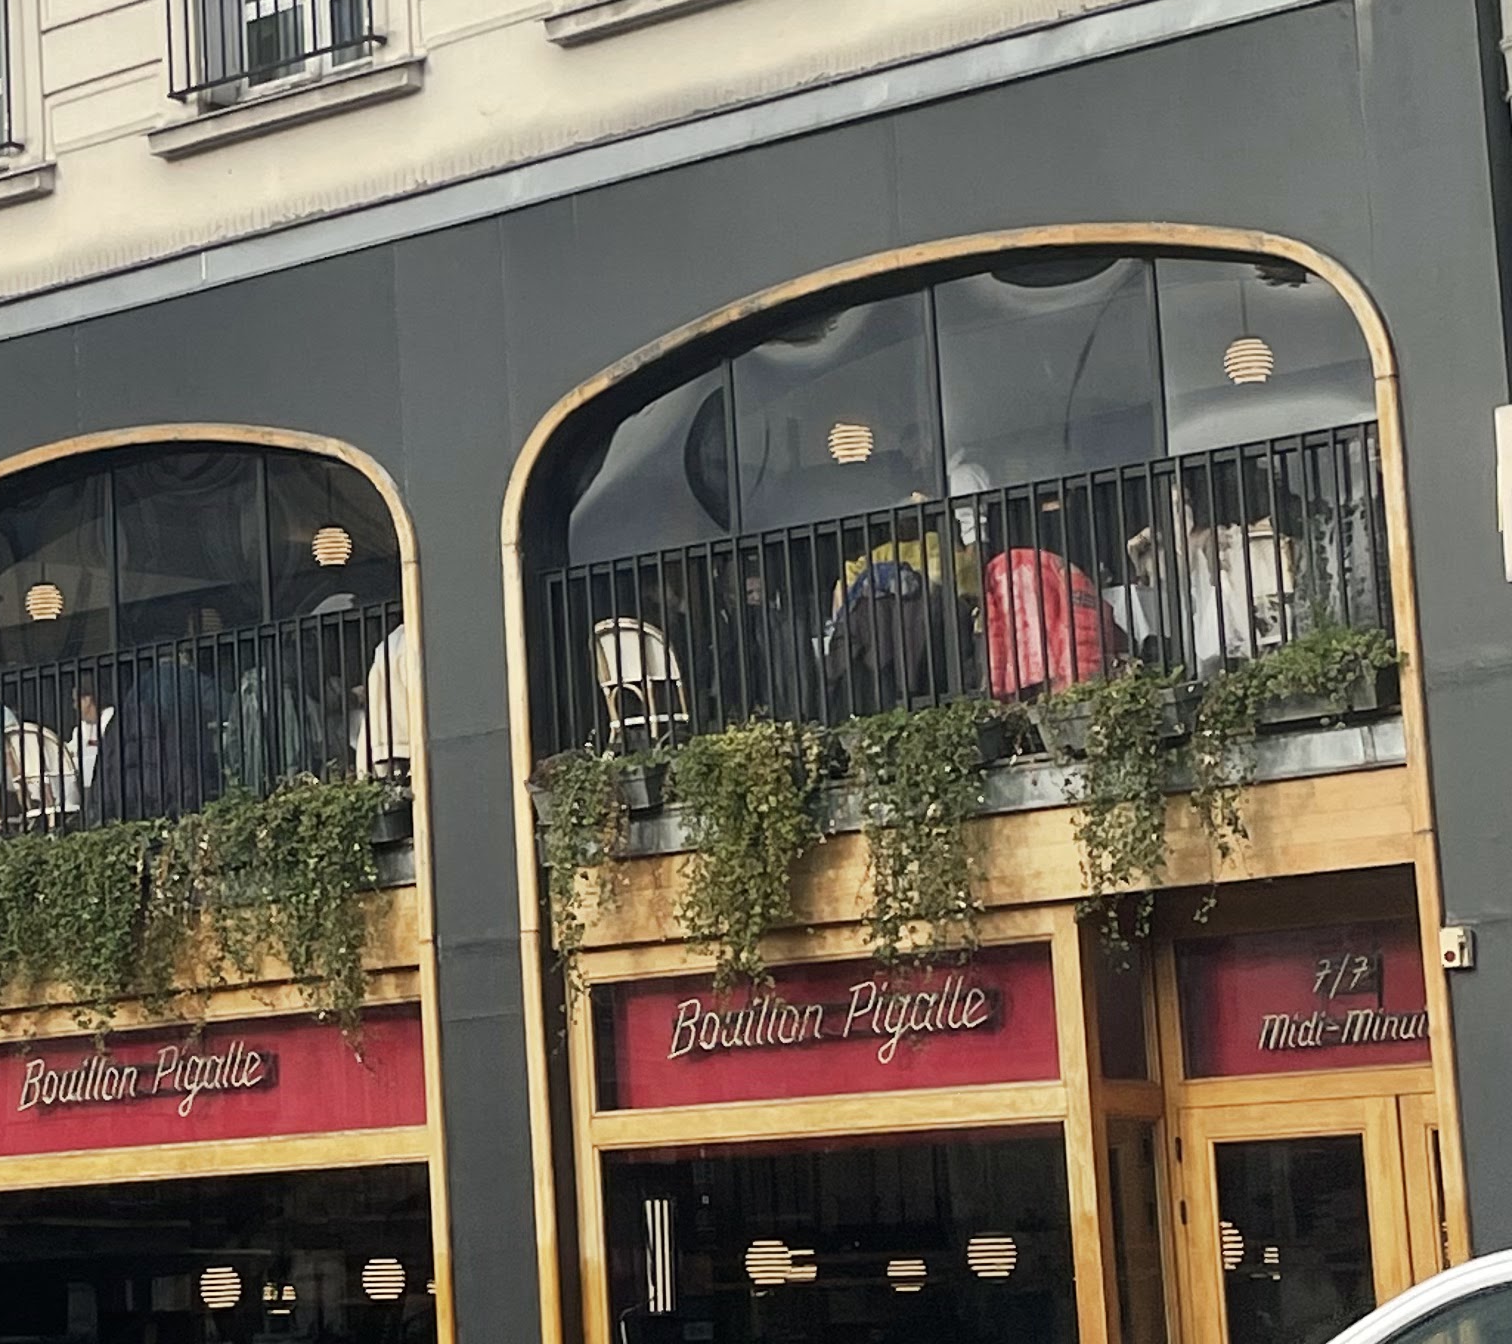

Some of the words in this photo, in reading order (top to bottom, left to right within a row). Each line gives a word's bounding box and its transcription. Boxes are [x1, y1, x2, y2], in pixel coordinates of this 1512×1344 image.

[1312, 953, 1369, 999] 7/7
[667, 995, 824, 1060] Bouillon
[842, 975, 989, 1064] Pigalle
[1258, 1007, 1430, 1051] Midi-Minui
[17, 1055, 137, 1112] Bouillon
[152, 1040, 264, 1117] Pigalle
